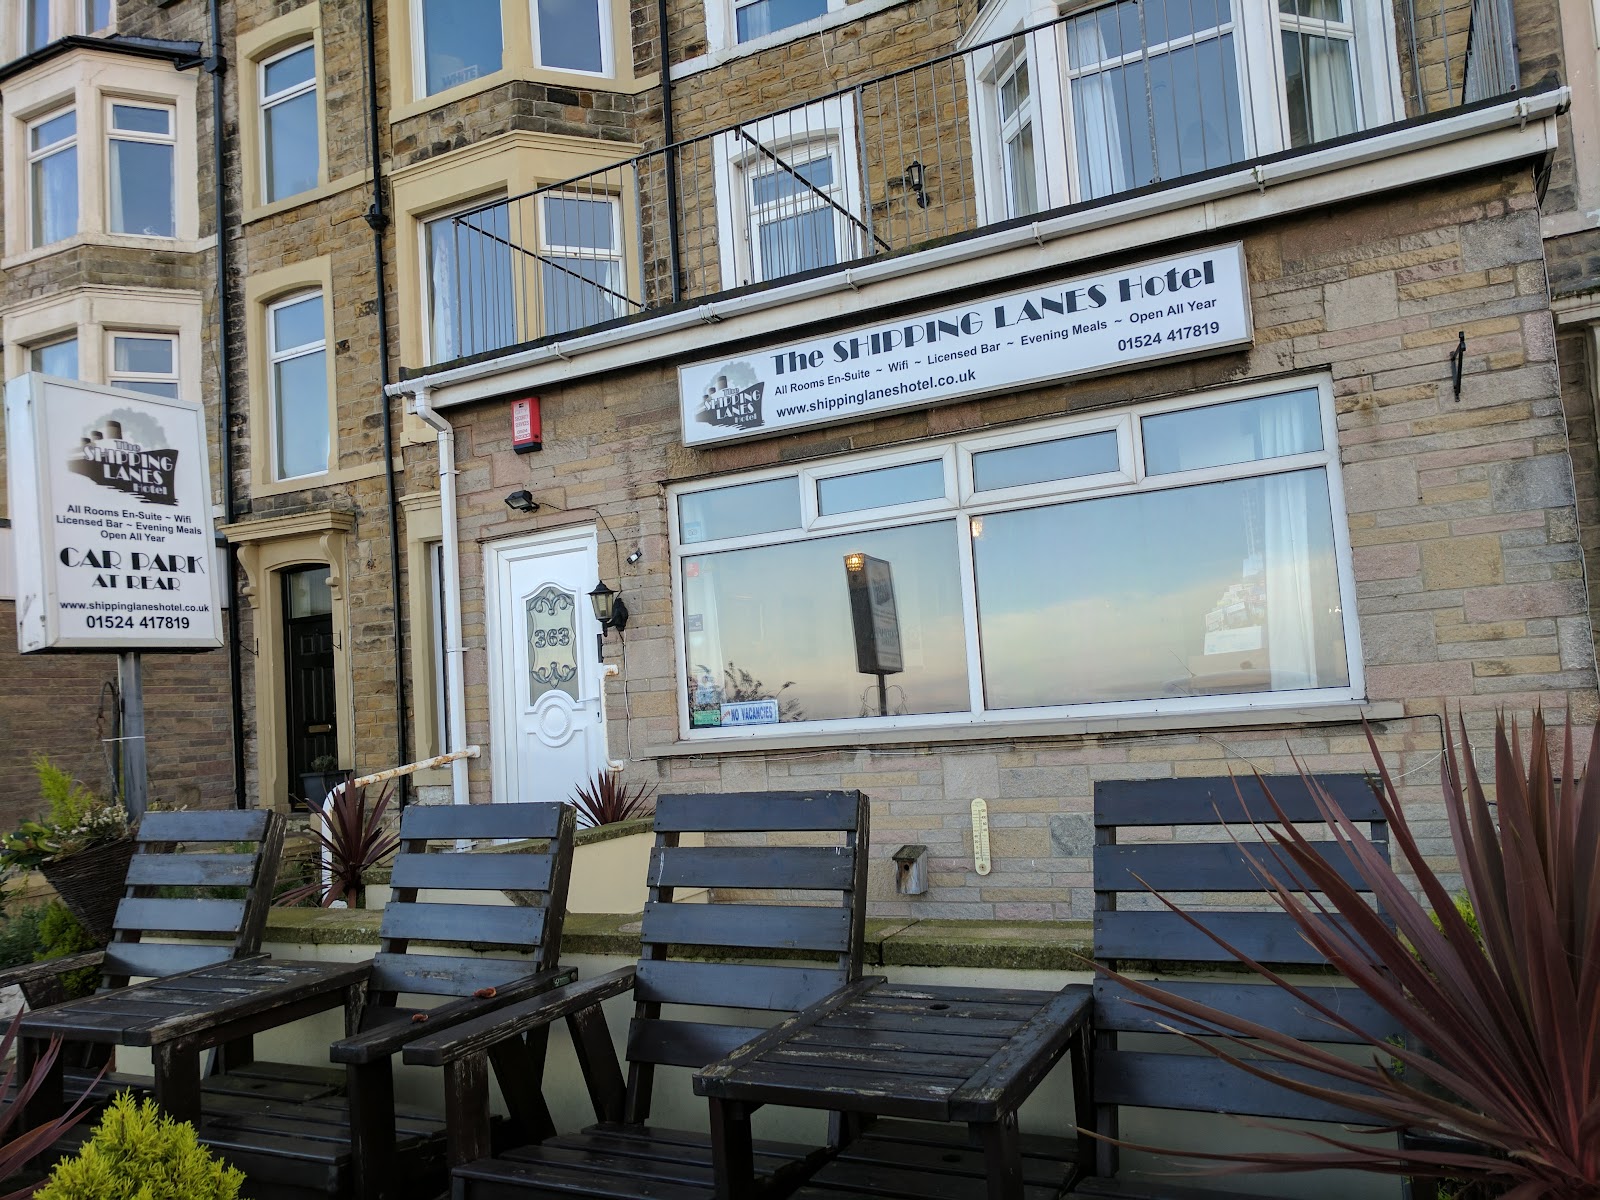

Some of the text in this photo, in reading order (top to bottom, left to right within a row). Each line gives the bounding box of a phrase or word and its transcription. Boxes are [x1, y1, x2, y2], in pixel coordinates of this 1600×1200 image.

[770, 260, 1215, 375] The SHIPPING LANES Hotel
[1118, 321, 1220, 351] 01524 417819
[774, 385, 787, 396] All
[790, 378, 824, 392] Rooms
[828, 369, 870, 385] En-Suite
[888, 360, 909, 373] Wifi
[928, 347, 977, 366] Licensed
[981, 342, 1001, 354] Bar
[1021, 324, 1069, 346] Evening
[1073, 319, 1108, 335] Meals
[1130, 310, 1164, 325] Open
[1166, 304, 1184, 318] All
[1187, 298, 1217, 312] Year
[704, 390, 760, 410] SHIPPING
[776, 369, 976, 418] www.shippinglaneshotel.co.uk
[716, 403, 754, 420] LANES
[734, 413, 757, 424] Hotel
[114, 440, 141, 452] The
[83, 445, 173, 472] SHIPPING
[103, 464, 164, 485] LANES
[133, 483, 168, 495] Hotel
[67, 504, 81, 514] All
[84, 506, 119, 517] Rooms
[122, 510, 162, 521] En-Suite
[174, 514, 192, 524] Wifi
[56, 515, 102, 527] Licensed
[106, 519, 123, 528] Bar
[136, 522, 173, 534] Evening
[177, 525, 202, 535] Meals
[100, 530, 165, 543] Open All Year
[60, 547, 205, 574] CAR PARK
[92, 574, 181, 591] AT REAR
[60, 601, 209, 613] www.shippinglaneshotel.co.uk
[86, 615, 190, 629] 01524 417819
[535, 627, 570, 648] 363
[731, 709, 739, 722] NO
[742, 706, 773, 720] VACANCIES
